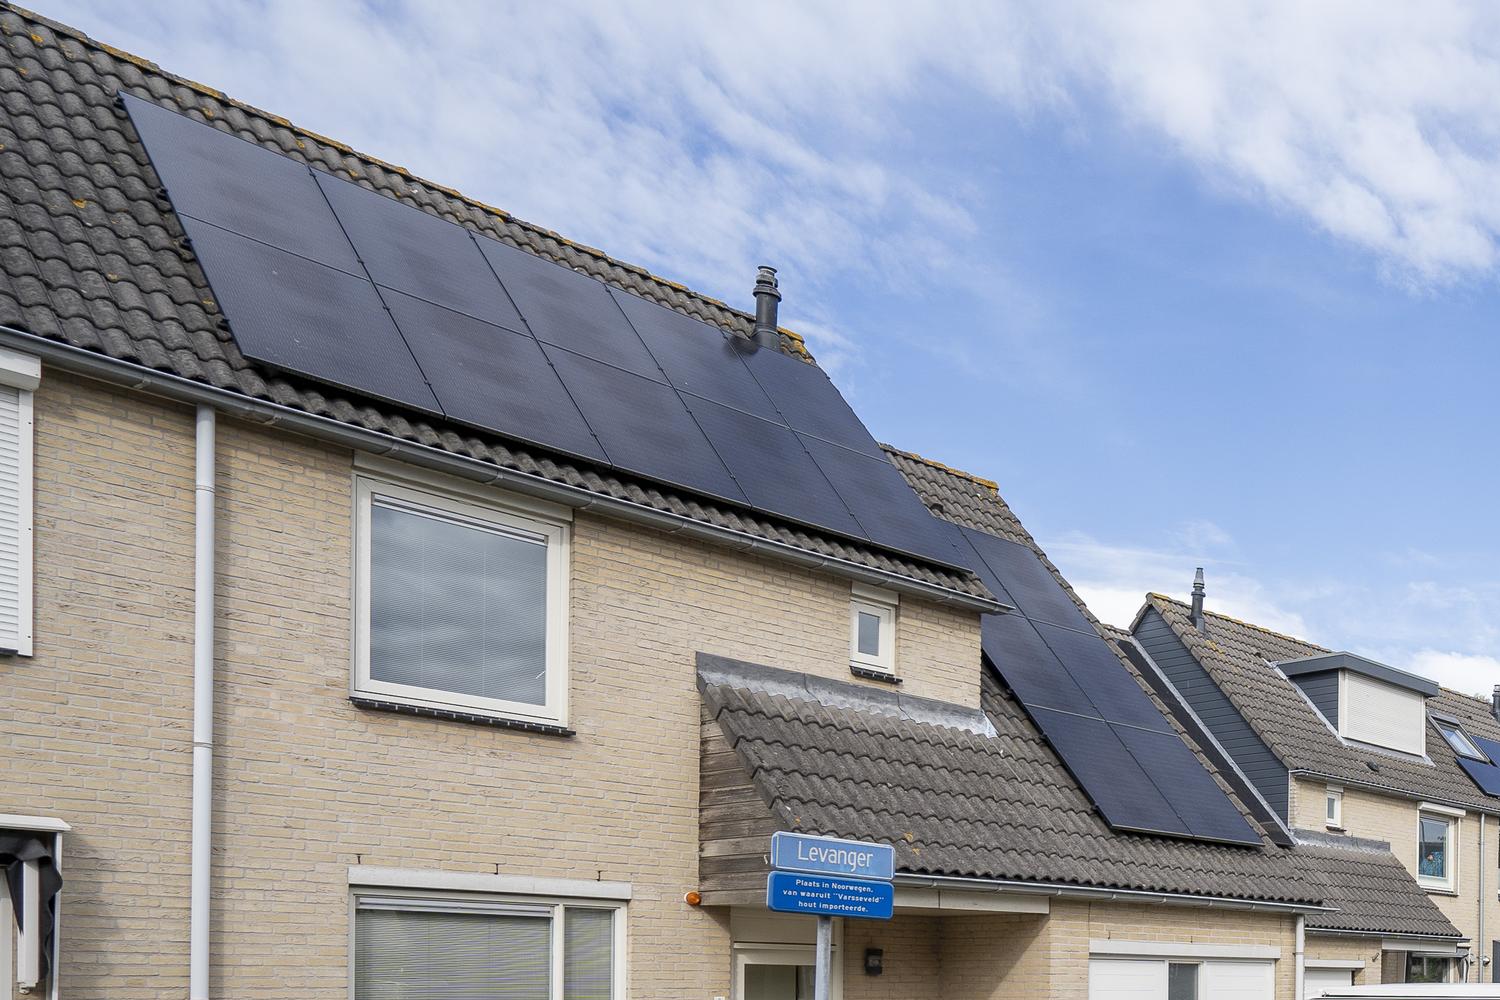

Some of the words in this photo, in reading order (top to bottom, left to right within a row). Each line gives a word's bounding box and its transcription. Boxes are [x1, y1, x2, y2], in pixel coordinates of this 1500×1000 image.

[797, 840, 874, 872] Levanger
[795, 879, 821, 888] Plaats
[800, 891, 831, 899] waaruit
[798, 900, 817, 908] hout
[819, 902, 869, 913] importeerde.
